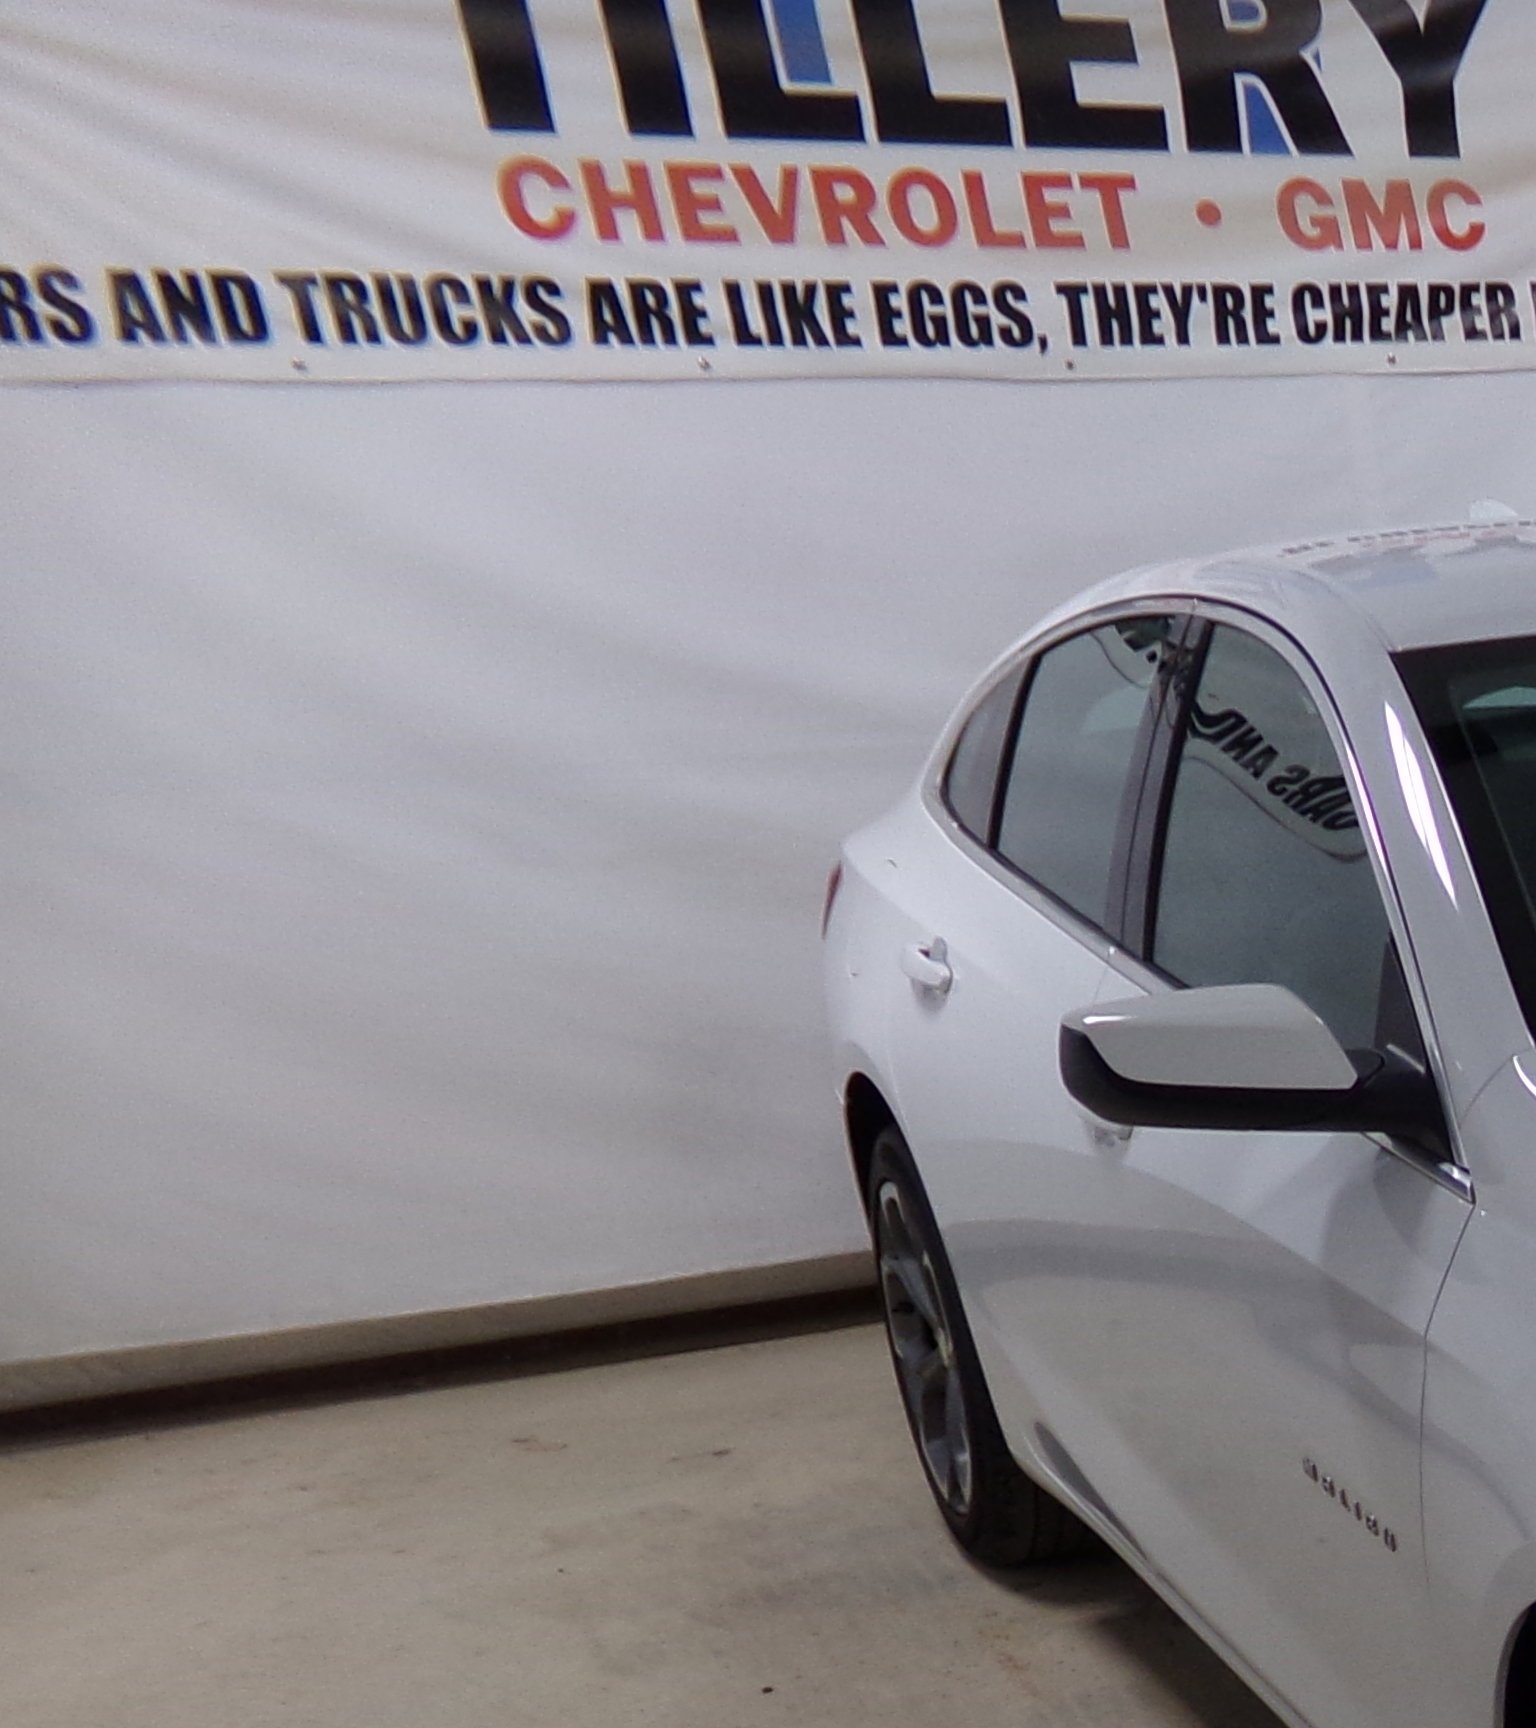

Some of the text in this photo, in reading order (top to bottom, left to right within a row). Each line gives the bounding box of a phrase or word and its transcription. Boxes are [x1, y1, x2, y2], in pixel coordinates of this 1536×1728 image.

[498, 155, 1486, 252] CHEVROLET GMC
[108, 268, 270, 345] AND
[274, 271, 571, 347] TRUCKS
[587, 278, 716, 347] ARE
[725, 279, 863, 348] LIKE
[878, 281, 1050, 355] EGGS,
[1055, 282, 1278, 348] THEY'RE
[1292, 280, 1519, 346] CHEAPER
